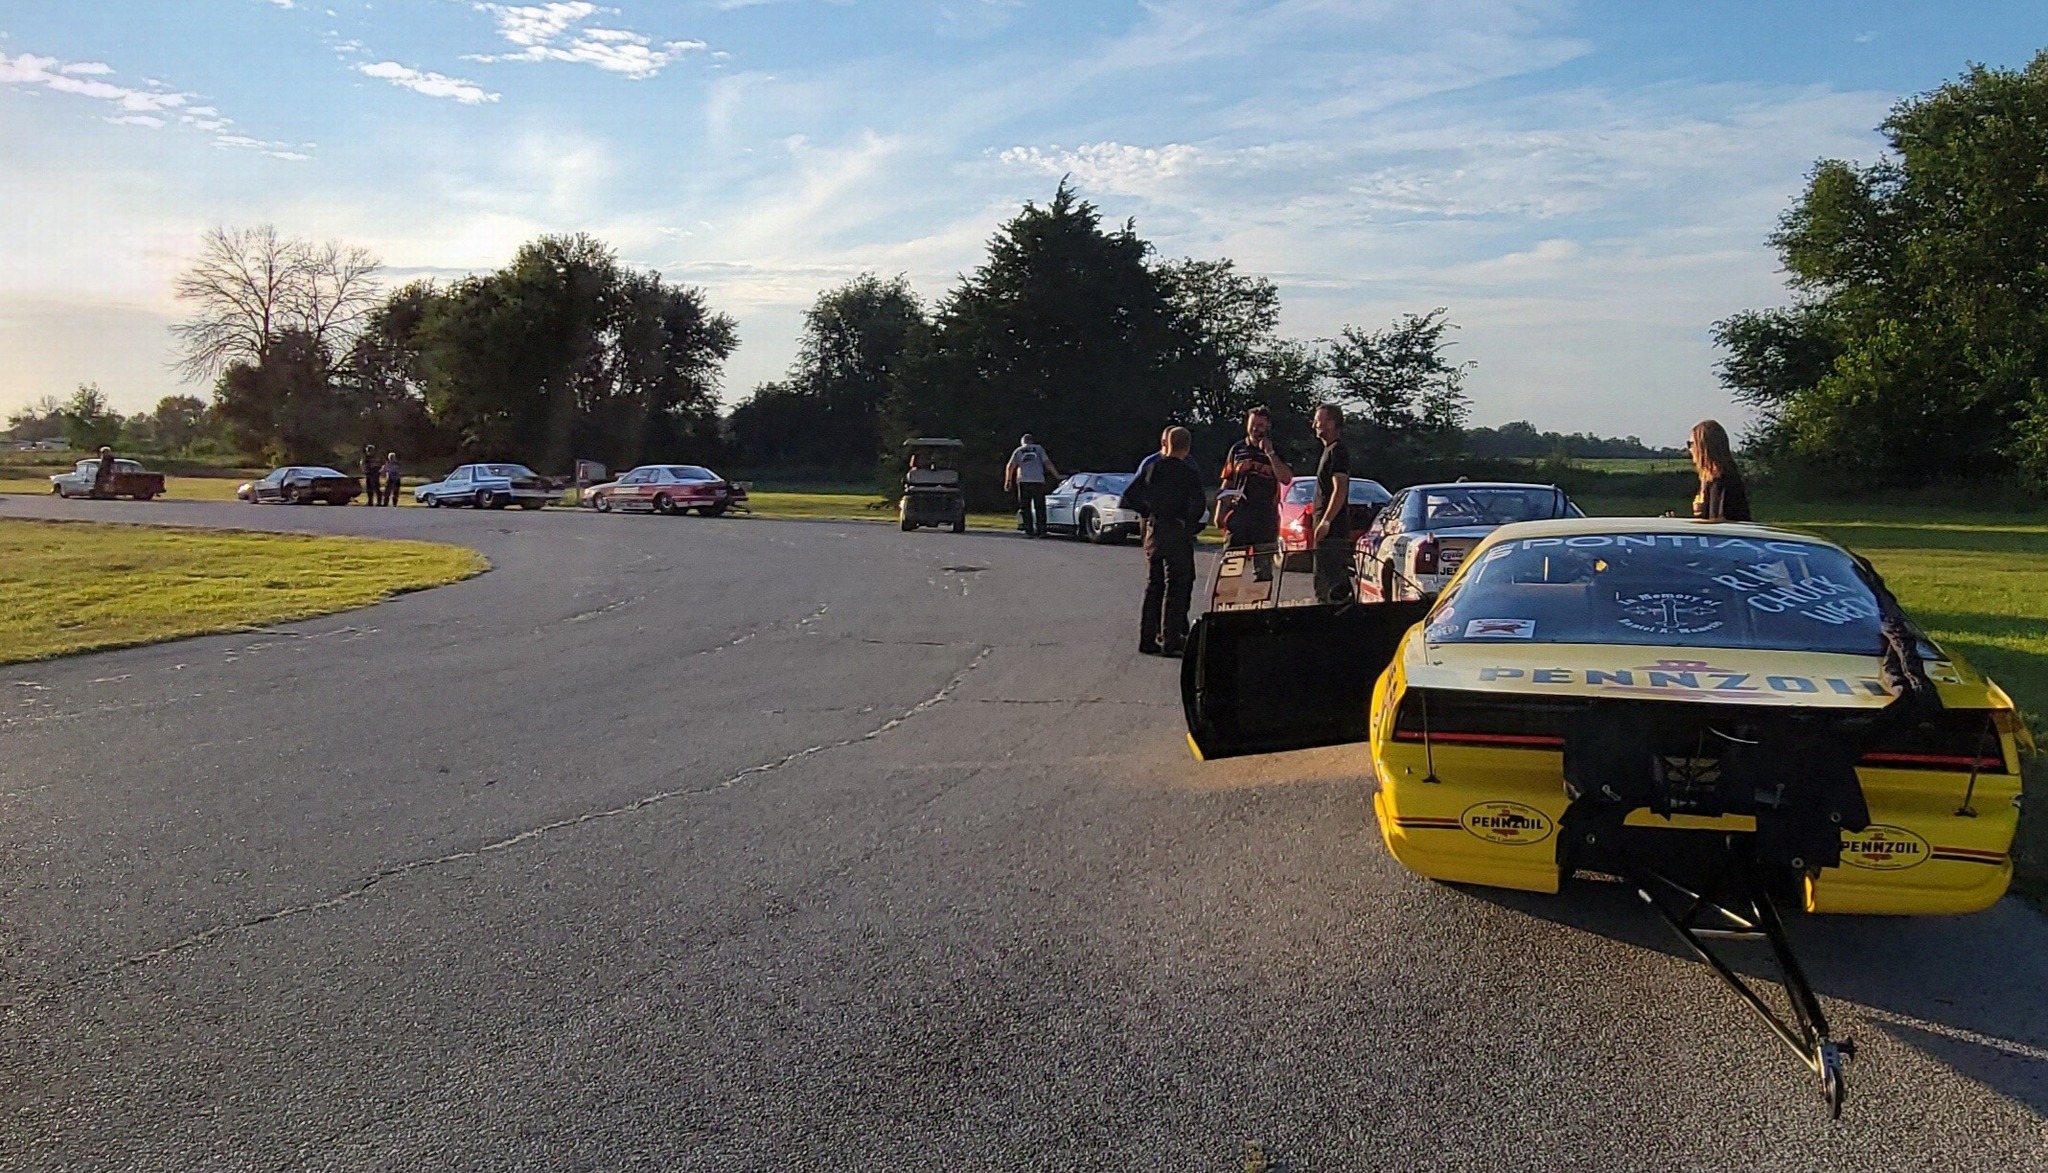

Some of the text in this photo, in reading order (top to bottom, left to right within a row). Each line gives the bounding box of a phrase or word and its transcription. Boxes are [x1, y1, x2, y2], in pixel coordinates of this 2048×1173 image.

[1522, 535, 1810, 556] PONTIAC
[1638, 593, 1701, 602] Memory
[1747, 575, 1856, 612] CHUCK
[1471, 816, 1544, 829] PENNZOIL
[1841, 841, 1920, 853] PENNZOIL
